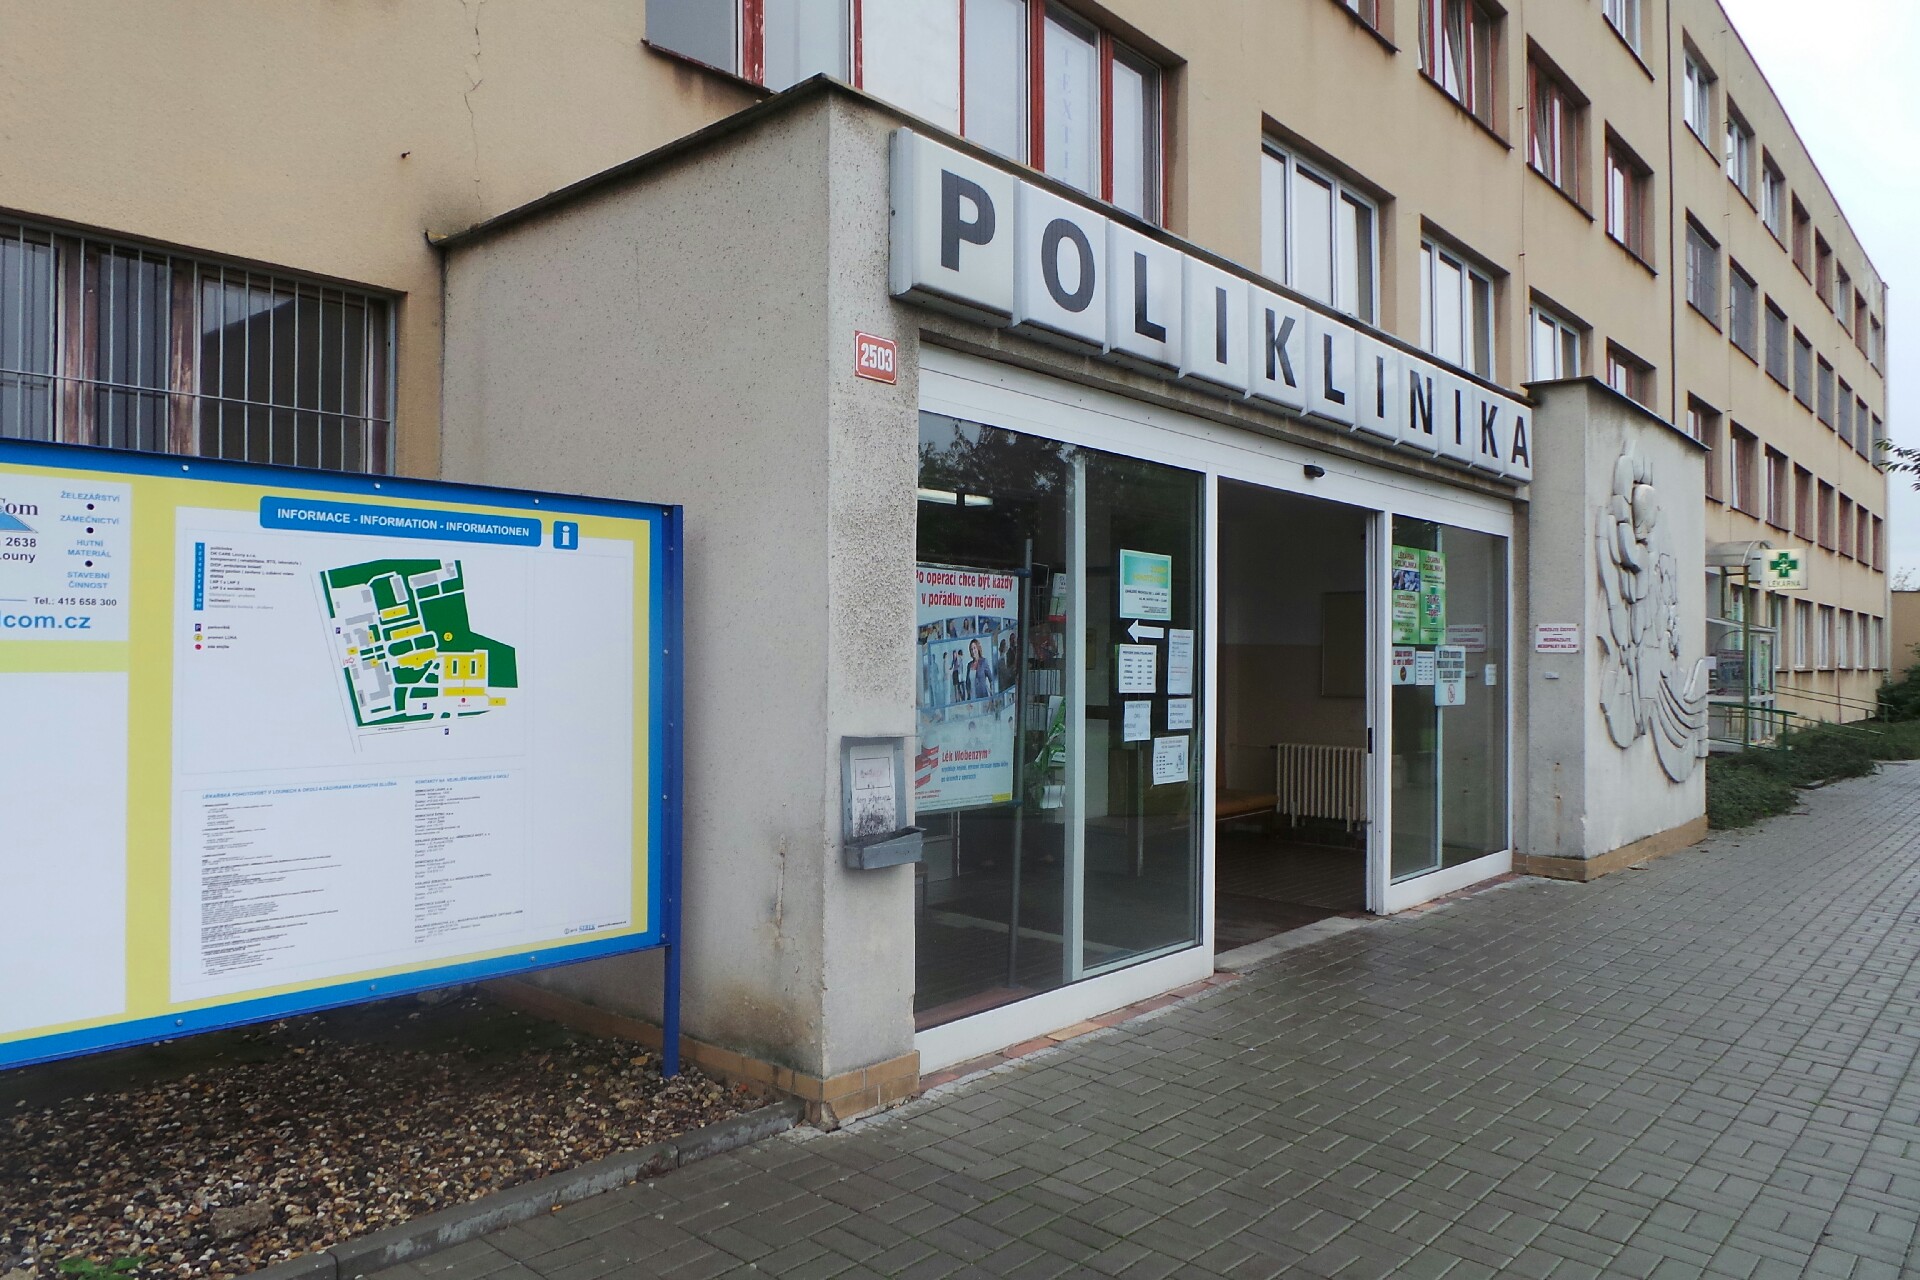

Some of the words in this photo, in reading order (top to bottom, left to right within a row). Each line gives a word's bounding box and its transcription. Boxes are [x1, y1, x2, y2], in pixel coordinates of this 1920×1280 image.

[940, 168, 1530, 470] POLIKLINIKA
[861, 342, 893, 372] 2503
[60, 490, 120, 502] ŽELEZÁŘSTVÍ
[0, 498, 38, 516] om
[60, 514, 119, 525] ZÁMEČNICTVÍ
[277, 508, 351, 524] INFORMACE
[360, 514, 438, 530] INFORMATION
[446, 521, 530, 537] INFORMATIONEN
[5, 536, 37, 548] 2638
[76, 538, 104, 547] HUTNÍ
[0, 552, 36, 564] ouny
[67, 548, 111, 558] MATERIÁL
[66, 570, 110, 579] STAVEBNÍ
[68, 579, 108, 589] ČINNOST
[927, 572, 956, 586] operaci
[959, 573, 975, 586] chce
[978, 574, 990, 590] být
[993, 575, 1013, 591] každý
[34, 597, 54, 605] Tel.:
[58, 598, 76, 606] 415
[79, 598, 97, 606] 658
[100, 598, 117, 607] 300
[921, 593, 926, 604] v
[929, 591, 961, 607] pořádku
[964, 595, 972, 607] co
[975, 595, 1005, 610] nejdříve
